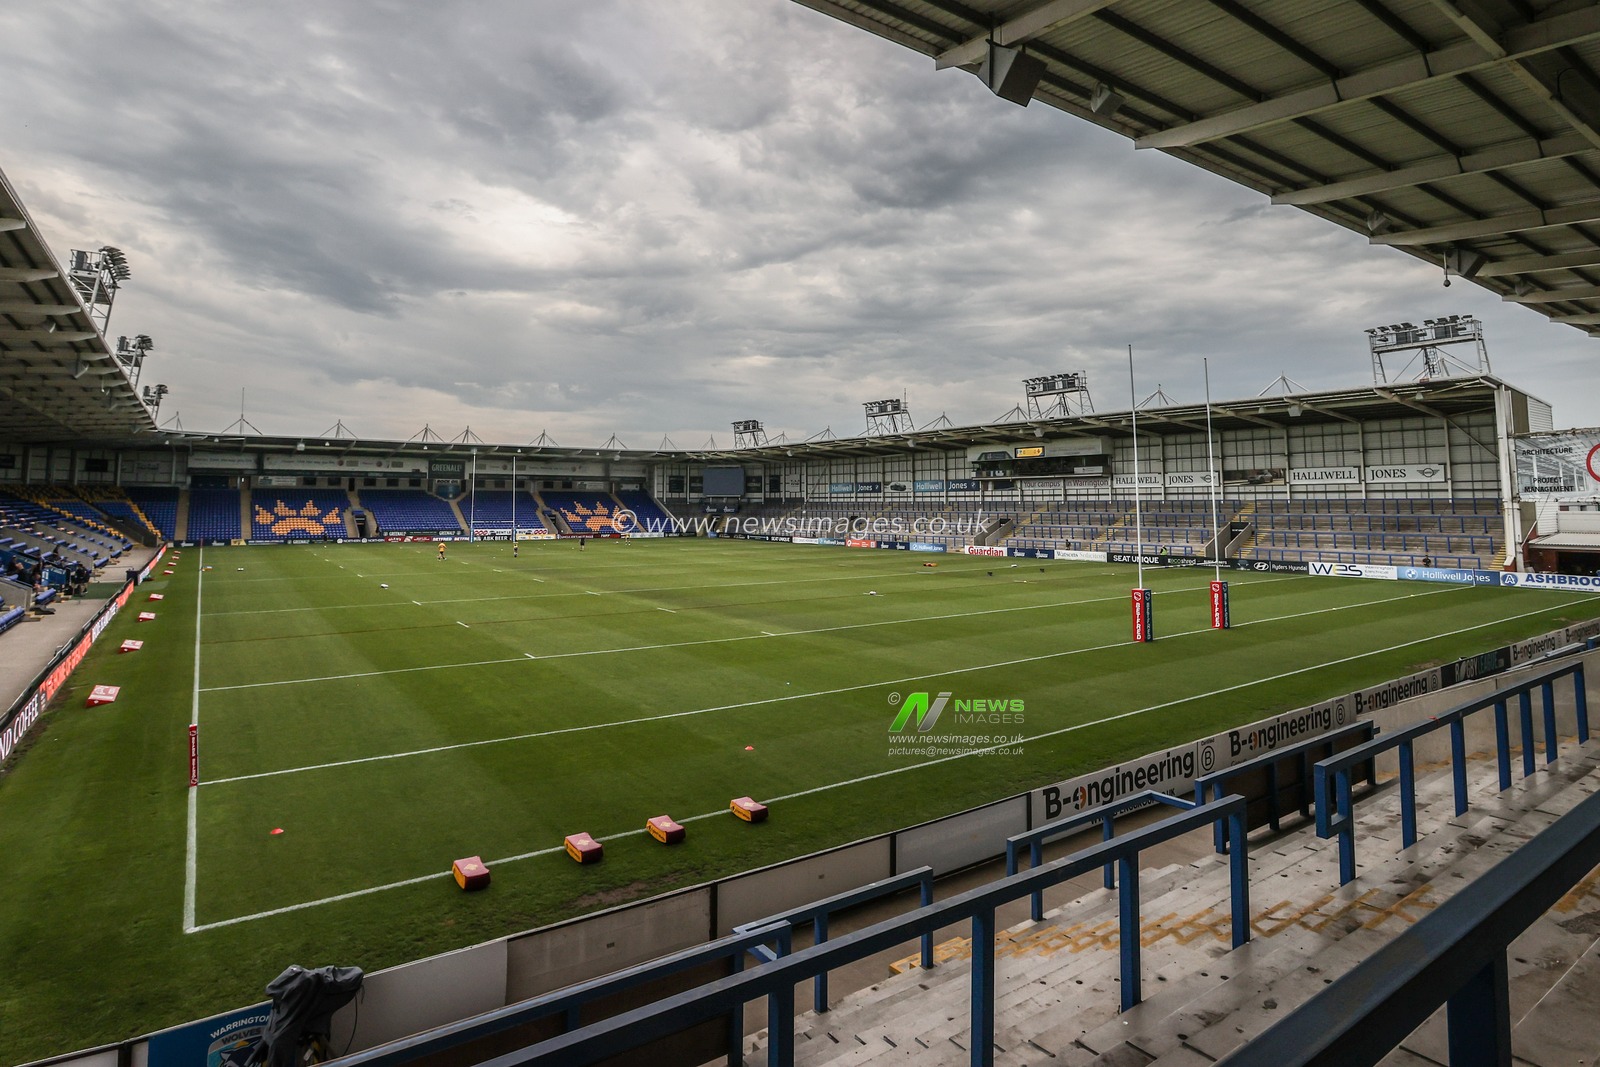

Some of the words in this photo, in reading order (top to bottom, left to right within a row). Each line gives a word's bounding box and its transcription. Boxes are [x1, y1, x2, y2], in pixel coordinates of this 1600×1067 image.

[1521, 446, 1573, 456] ARCHITECTURE
[1115, 475, 1160, 485] HALLWELL
[1168, 475, 1194, 485] JONES
[1293, 470, 1356, 481] HALLIWELL
[1370, 468, 1407, 481] JONES
[1533, 476, 1563, 484] PROJECT
[858, 484, 873, 492] Jones
[916, 481, 943, 490] Halliwell
[949, 481, 968, 490] Jones
[1524, 485, 1574, 493] MANAGEMENT
[968, 545, 1004, 557] Guardian
[1113, 554, 1130, 563] SEAT
[1272, 563, 1288, 572] Ryders
[1288, 564, 1308, 572] Hyundai
[1422, 570, 1461, 581] Halliwell
[1463, 573, 1491, 582] Jones
[1512, 635, 1556, 661] B-engineering
[1354, 675, 1428, 714] B-engineering
[13, 693, 39, 744] COFFEE
[1228, 706, 1331, 757] B-engineering
[1042, 750, 1195, 820] B-engineering
